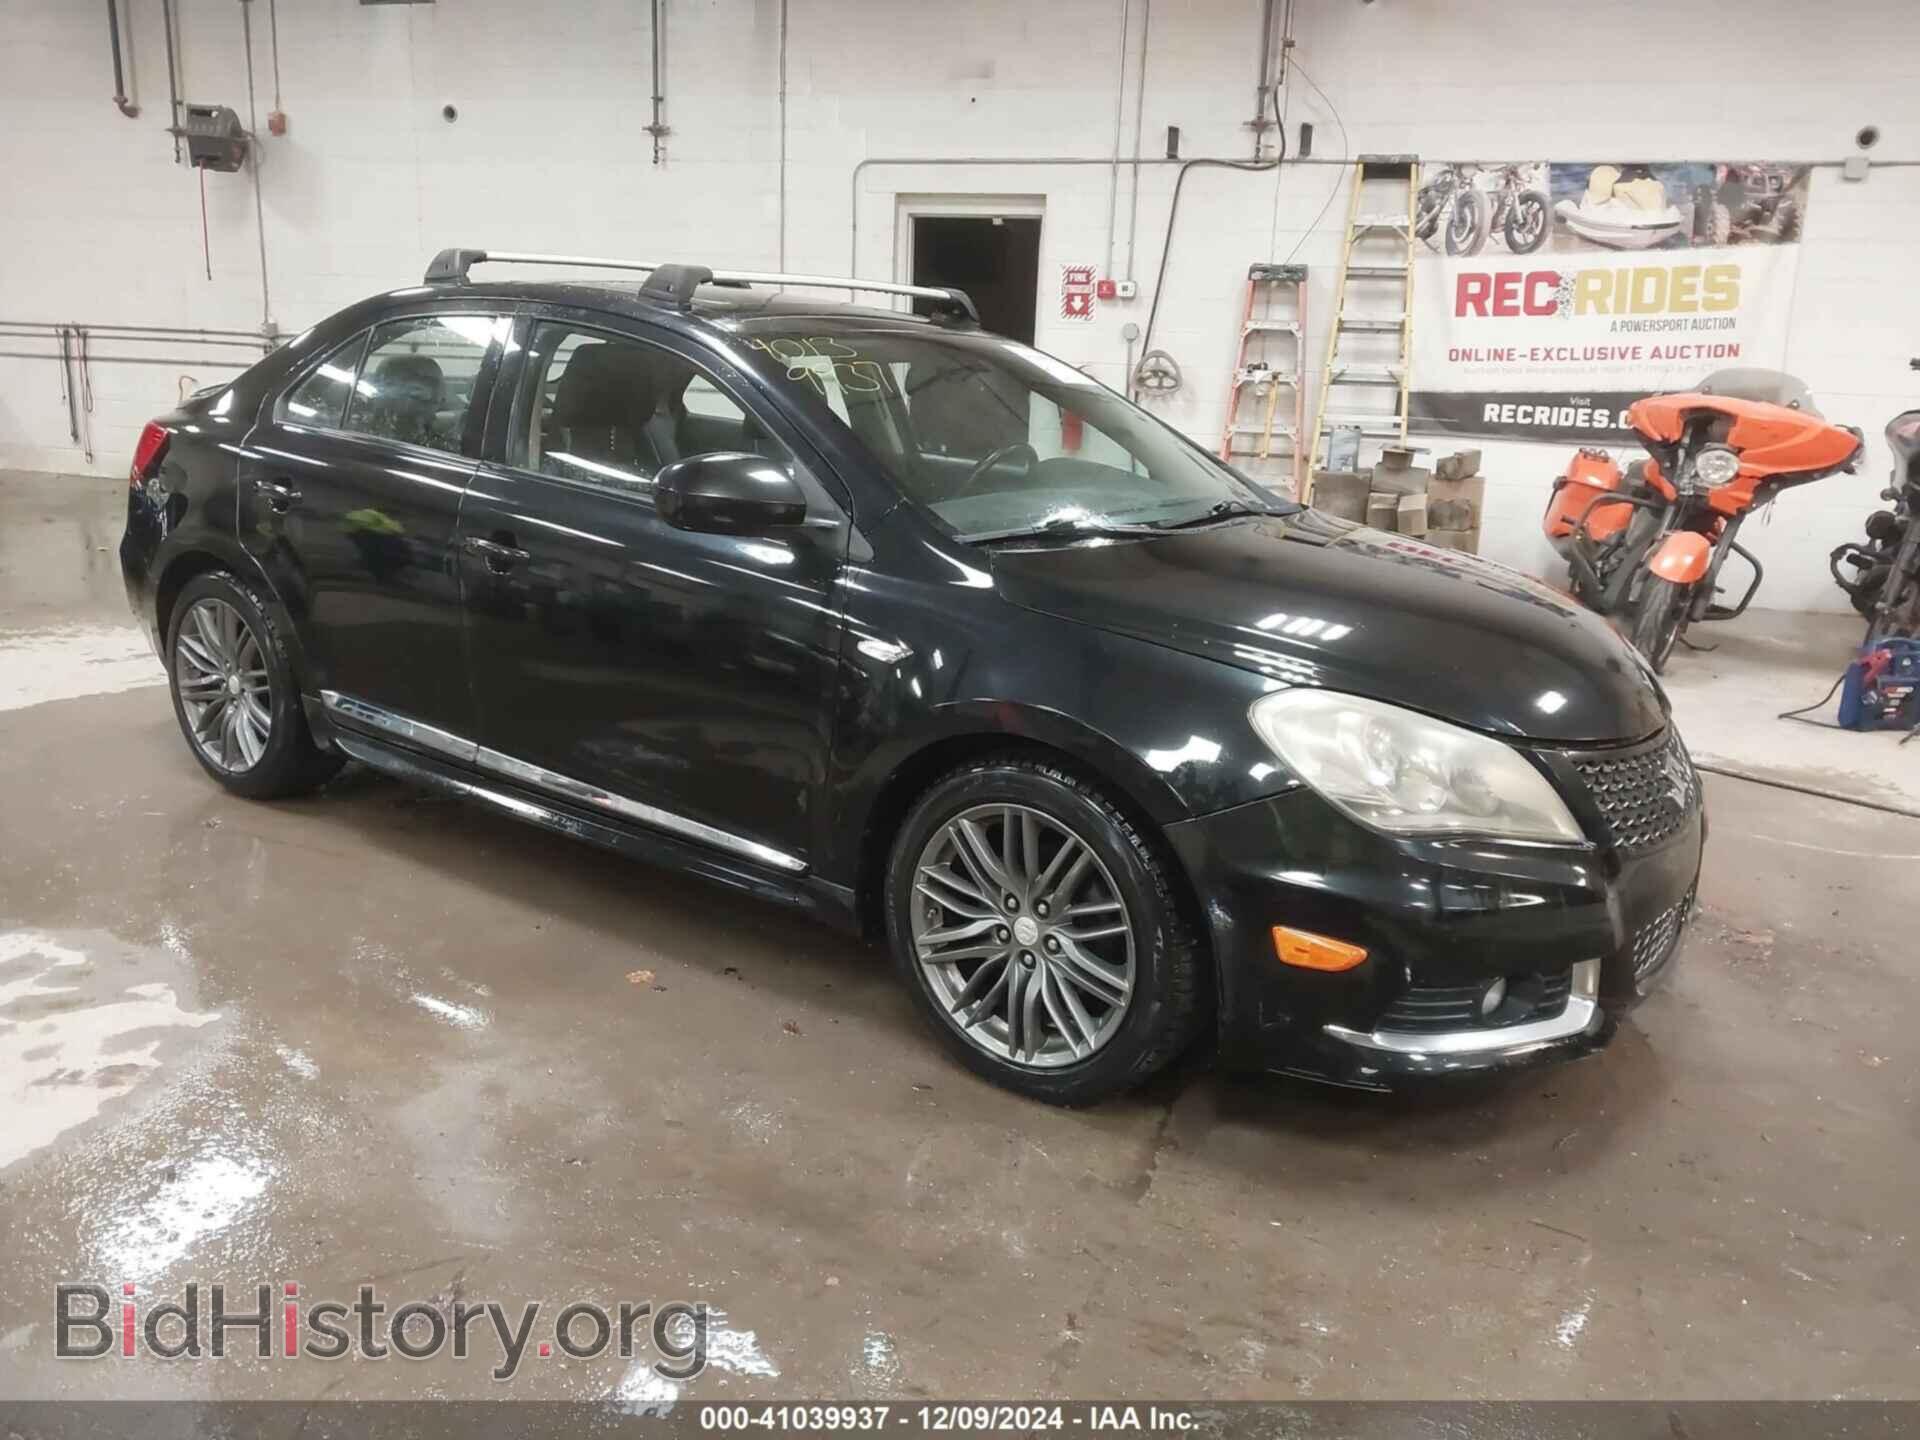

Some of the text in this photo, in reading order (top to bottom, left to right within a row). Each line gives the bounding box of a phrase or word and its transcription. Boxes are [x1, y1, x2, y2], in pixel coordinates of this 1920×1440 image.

[1455, 264, 1741, 317] REC RIDES
[1610, 317, 1736, 333] A POWERSPORT AUCTION
[1448, 343, 1741, 362] ONLINE-EXCLUSIVE AUCTION
[1569, 397, 1591, 406] Visit
